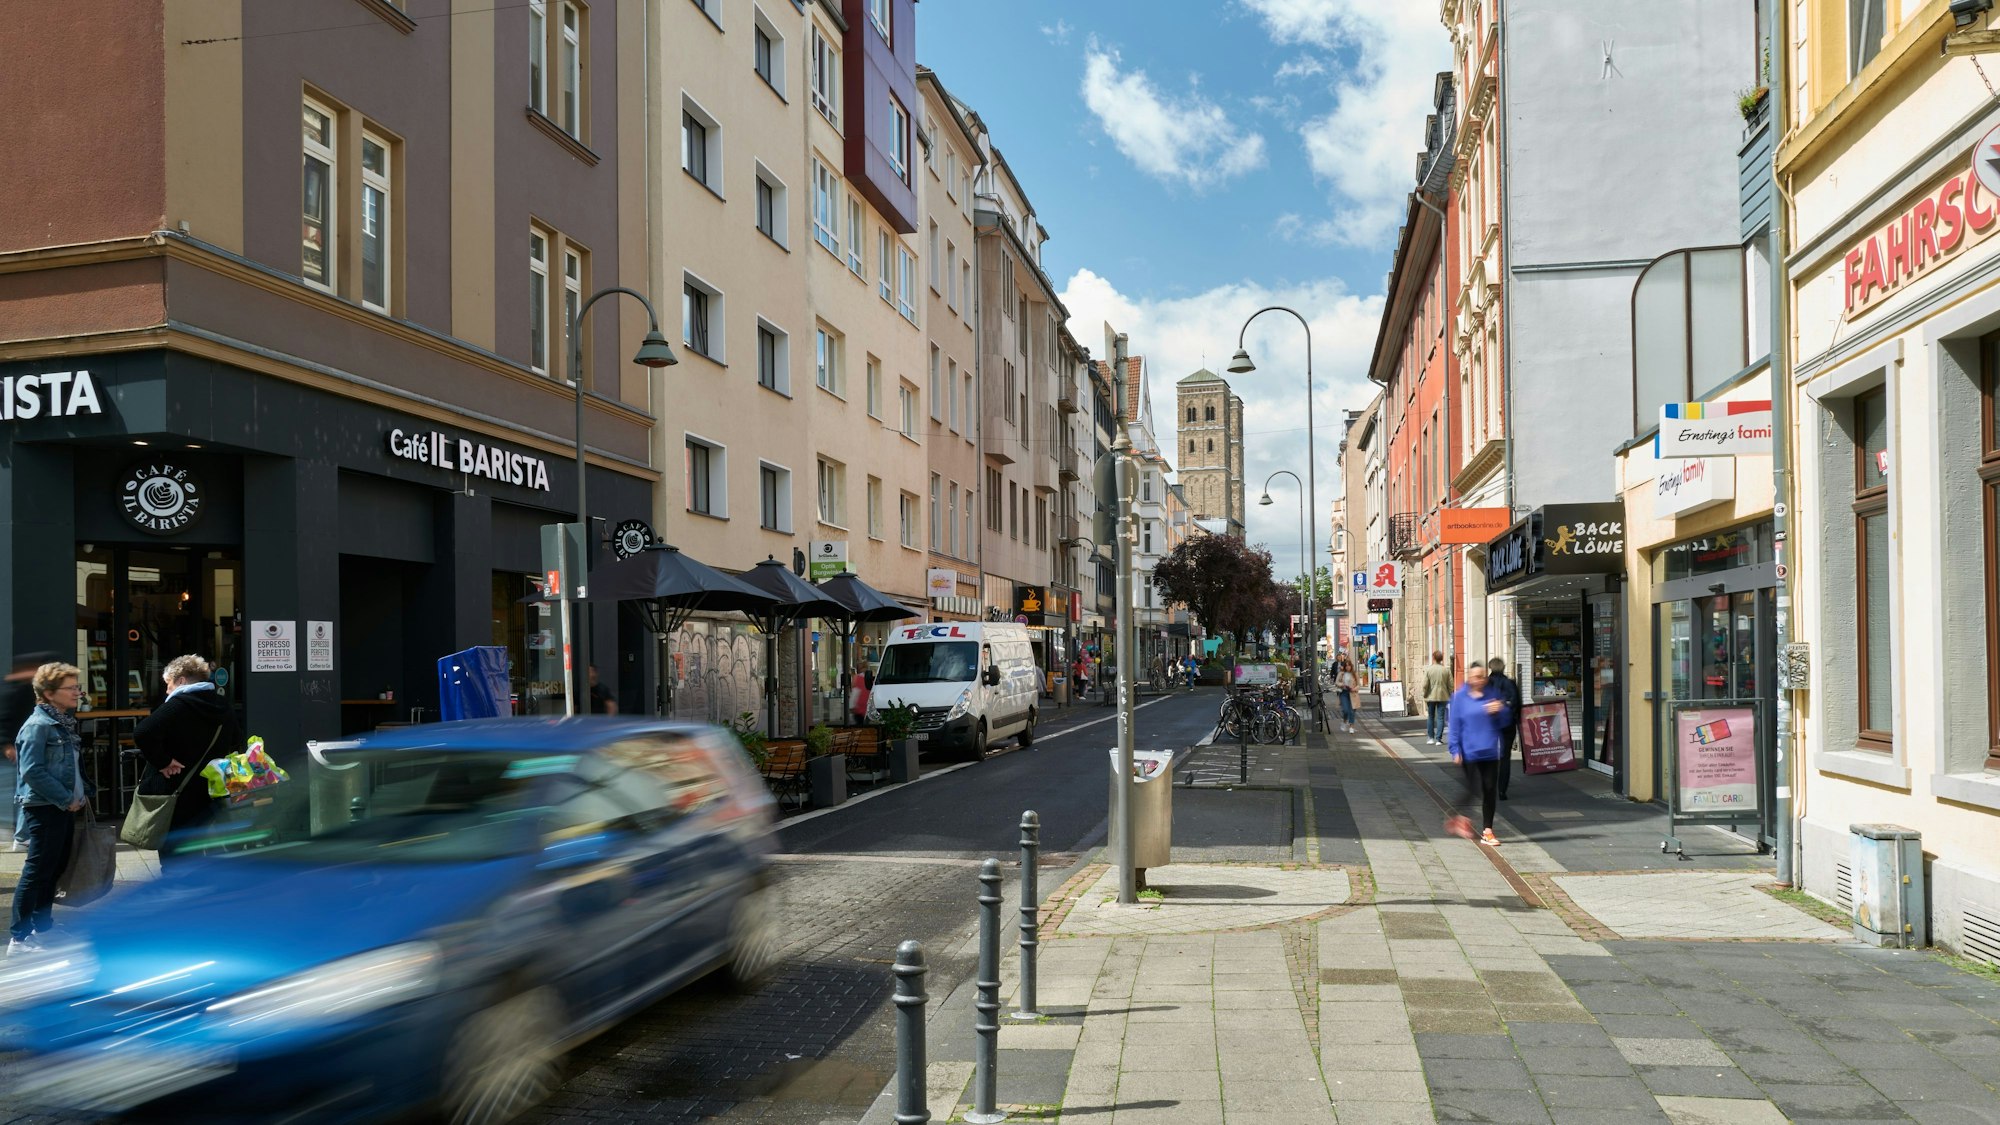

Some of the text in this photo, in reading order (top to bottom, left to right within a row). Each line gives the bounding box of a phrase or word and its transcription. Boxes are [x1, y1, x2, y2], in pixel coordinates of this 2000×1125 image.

[1845, 168, 2000, 310] FAHRSC
[0, 370, 102, 421] ISTA
[1678, 424, 1772, 445] Ernsting's fami
[389, 428, 550, 492] Café IL BARISTA
[135, 464, 188, 482] CAFÉ
[1683, 457, 1705, 484] family
[122, 494, 200, 530] IL BARISTA
[1446, 521, 1503, 531] artbooksonline.de
[1574, 521, 1623, 536] BACK
[1573, 537, 1624, 555] LÖWE
[257, 640, 291, 649] ESPRESSO
[257, 648, 291, 657] PERFETTO
[1693, 794, 1744, 804] FAMILY CARD
